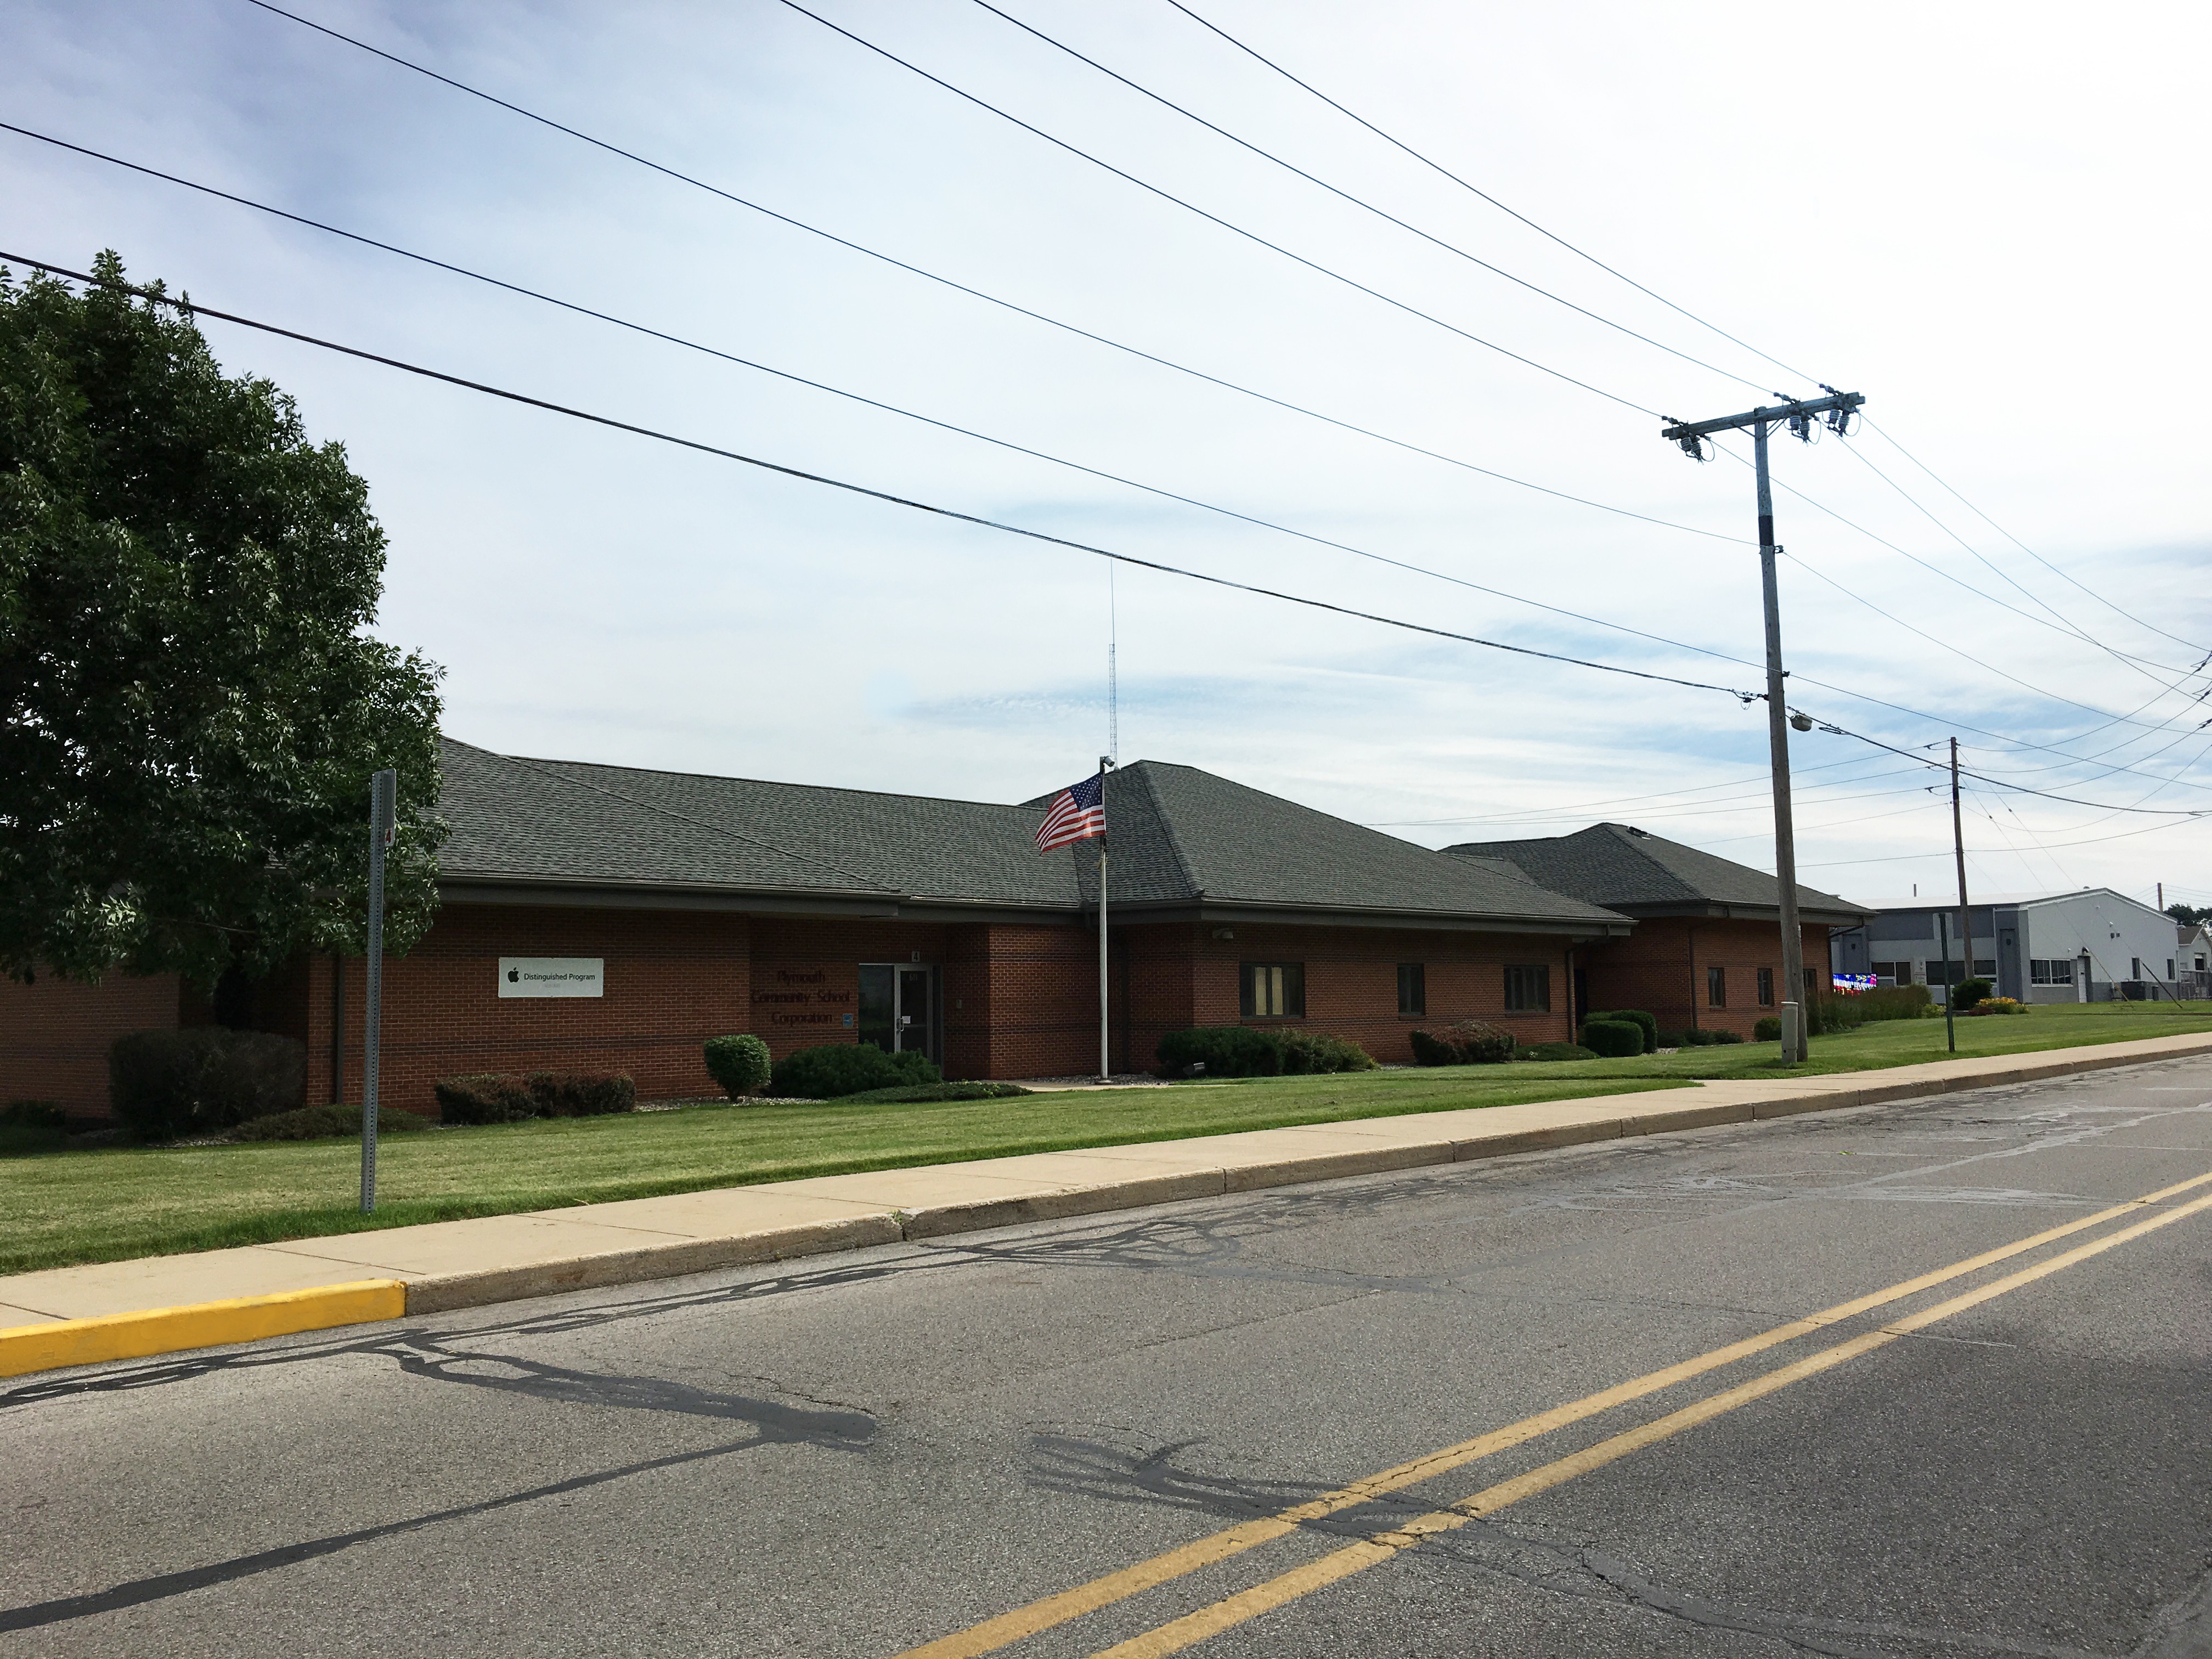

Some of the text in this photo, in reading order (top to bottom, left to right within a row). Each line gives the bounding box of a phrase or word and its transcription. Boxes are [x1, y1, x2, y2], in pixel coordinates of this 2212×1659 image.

[913, 952, 918, 961] 4
[524, 973, 595, 981] Distinguished Program
[777, 970, 825, 986] Plymouth
[751, 990, 850, 1006] Community School
[771, 1011, 832, 1027] Corporation
